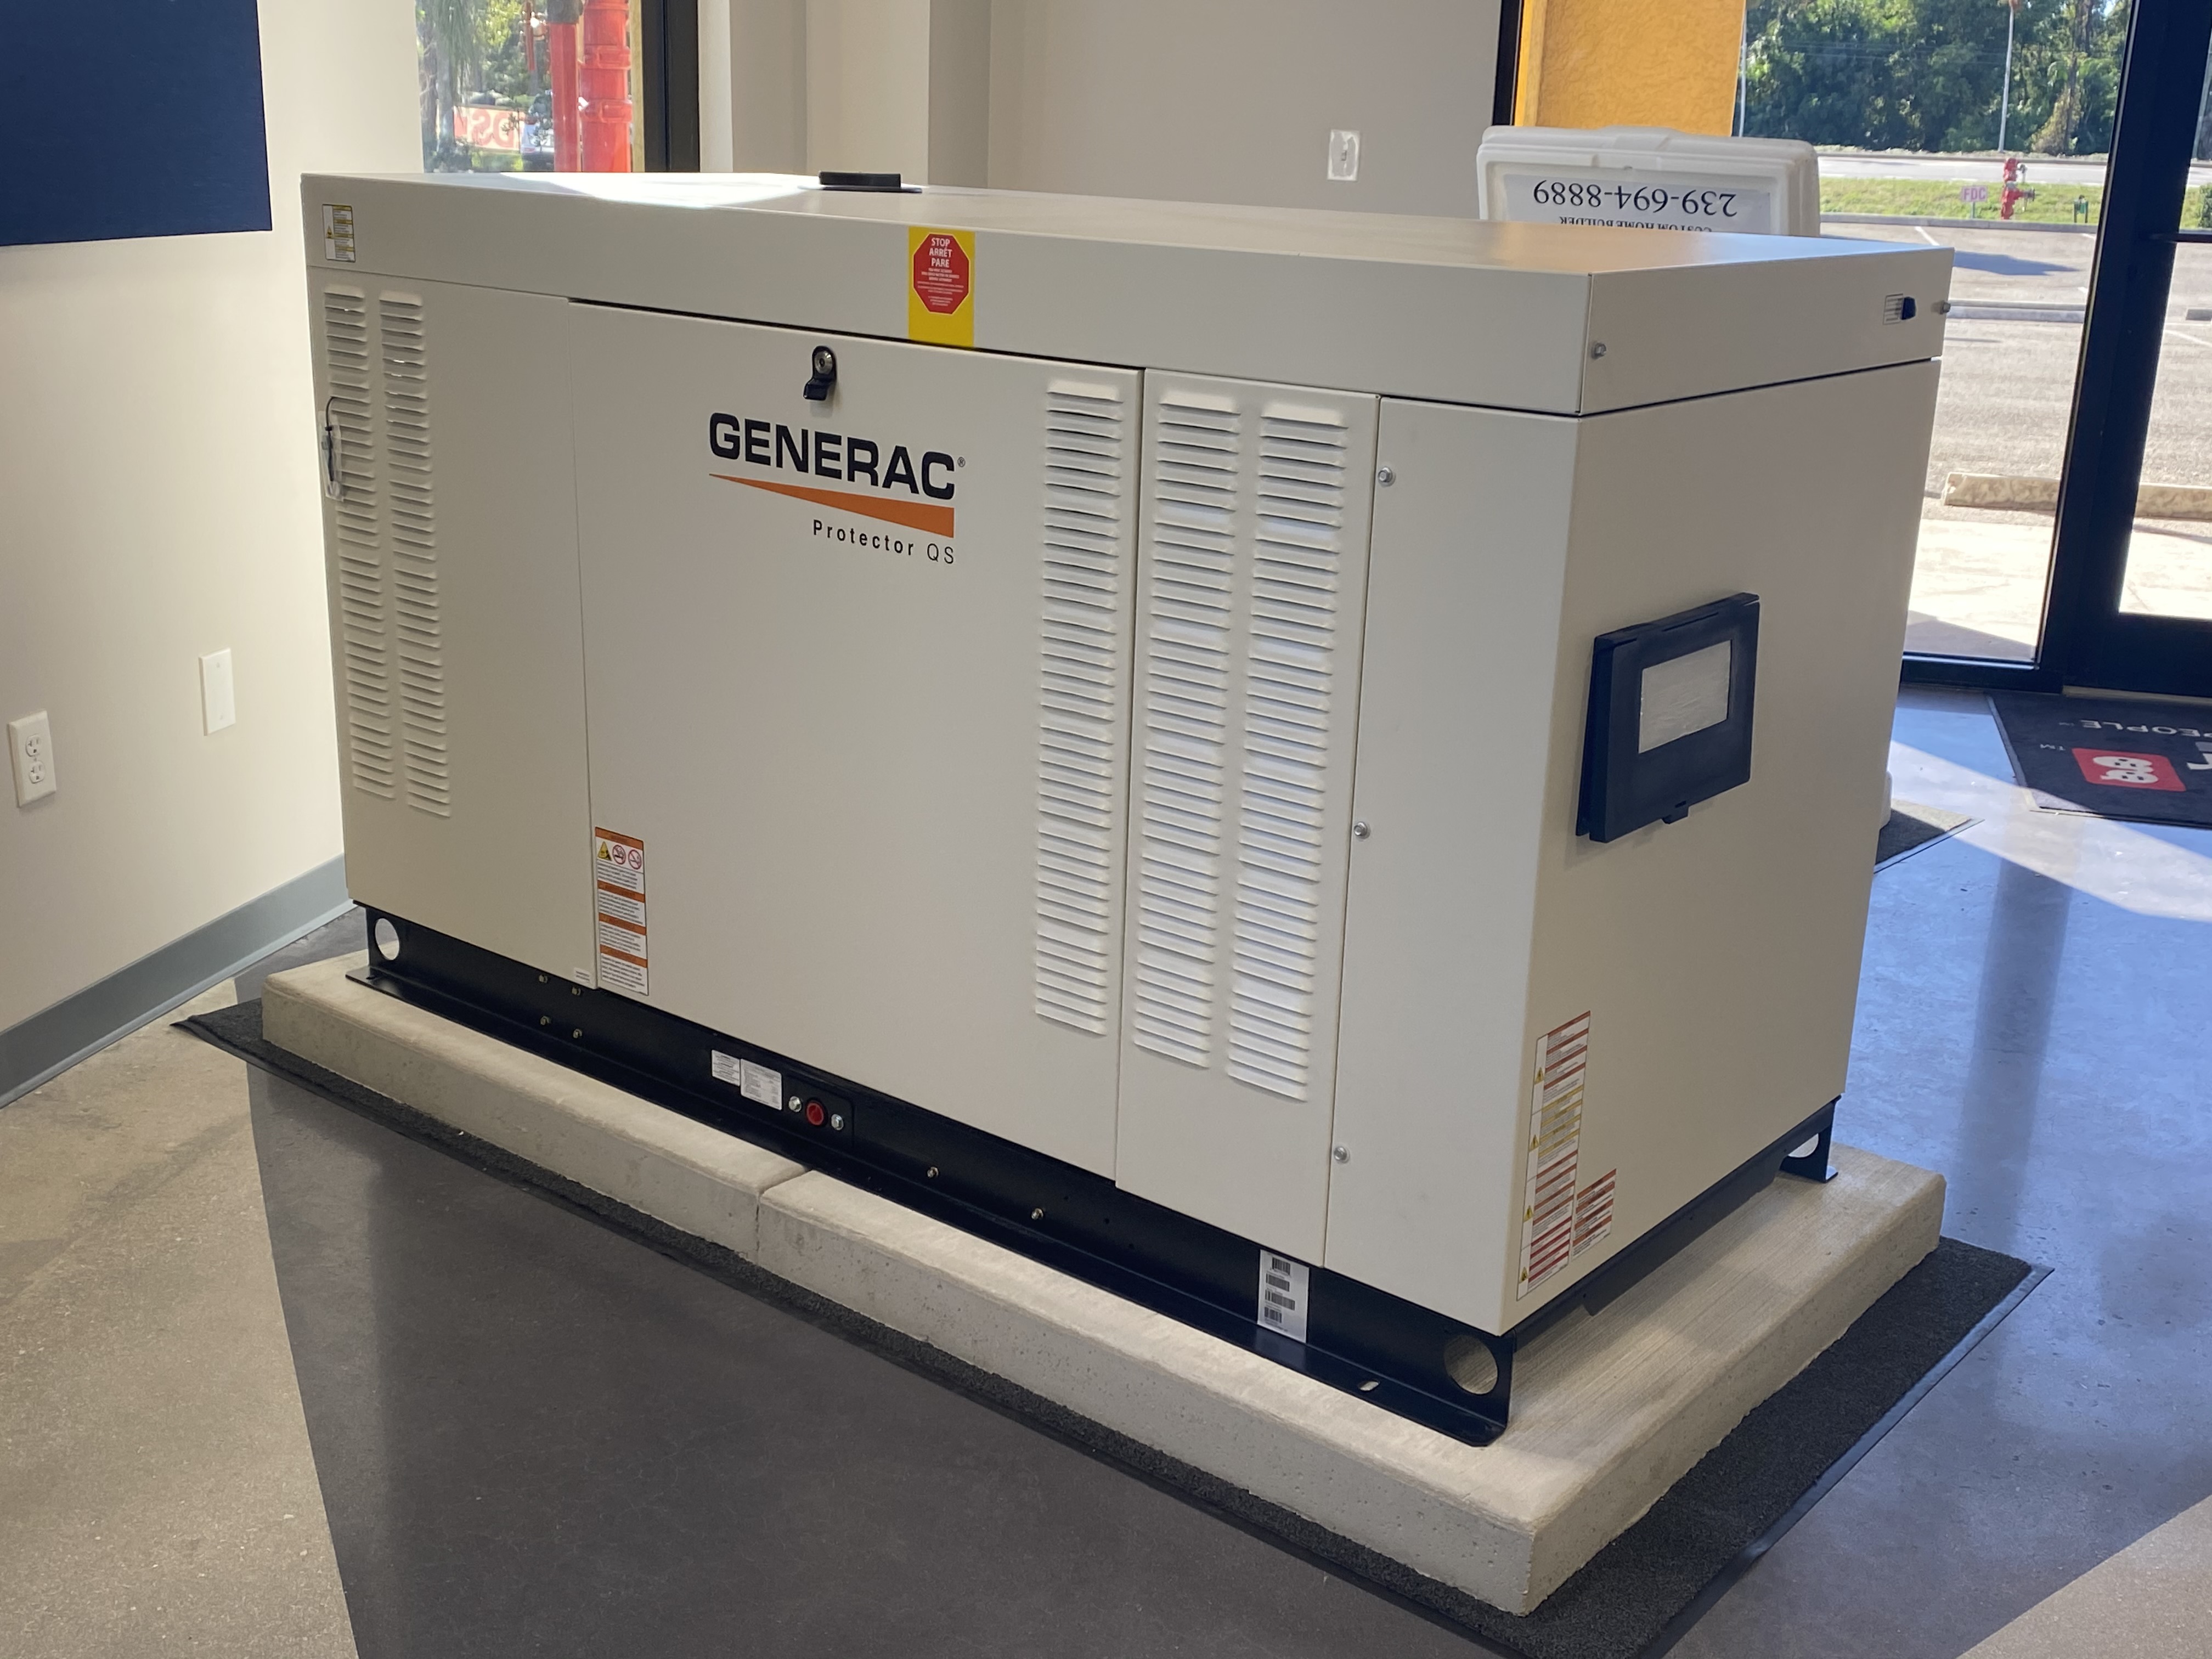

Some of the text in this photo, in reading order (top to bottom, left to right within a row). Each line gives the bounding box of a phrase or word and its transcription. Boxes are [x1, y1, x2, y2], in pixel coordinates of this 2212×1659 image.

[1533, 179, 1738, 217] 239-694-8889
[1963, 187, 1986, 201] FDC
[931, 238, 950, 247] STOP
[931, 257, 950, 268] PARE
[813, 519, 955, 564] Protector QS
